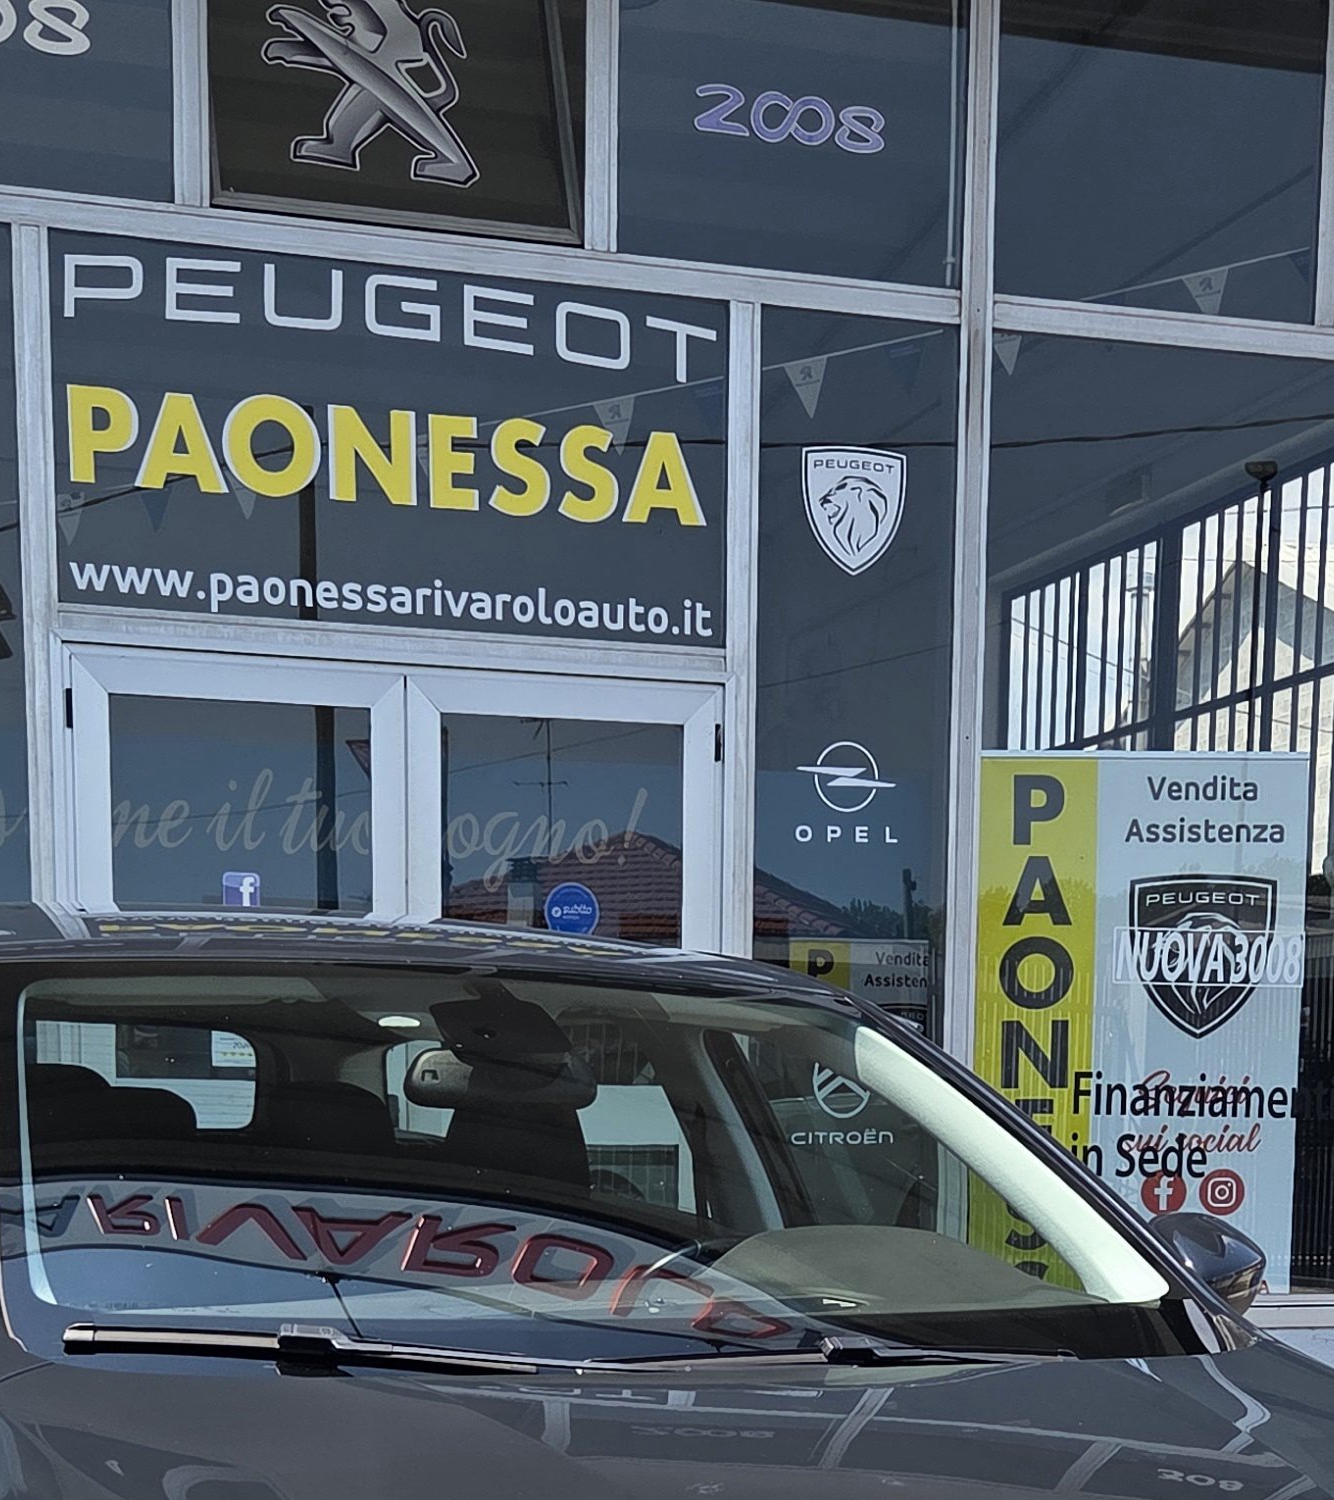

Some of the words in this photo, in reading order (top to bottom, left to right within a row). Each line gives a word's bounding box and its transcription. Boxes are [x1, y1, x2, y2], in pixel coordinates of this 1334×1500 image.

[695, 83, 886, 153] 2008
[64, 254, 717, 382] PEUGEOT
[66, 384, 707, 528] PAONESSA
[813, 459, 895, 474] PEUGEOT
[70, 561, 713, 637] www.paonessarivaroloauto.it
[1147, 776, 1259, 801] Vendita
[794, 825, 898, 844] OPEL
[1125, 818, 1285, 843] Assistenza
[1146, 892, 1260, 906] PEUGEOT
[1116, 931, 1229, 983] NUOVA
[1233, 932, 1304, 983] 3008
[1115, 1132, 1207, 1177] Sede
